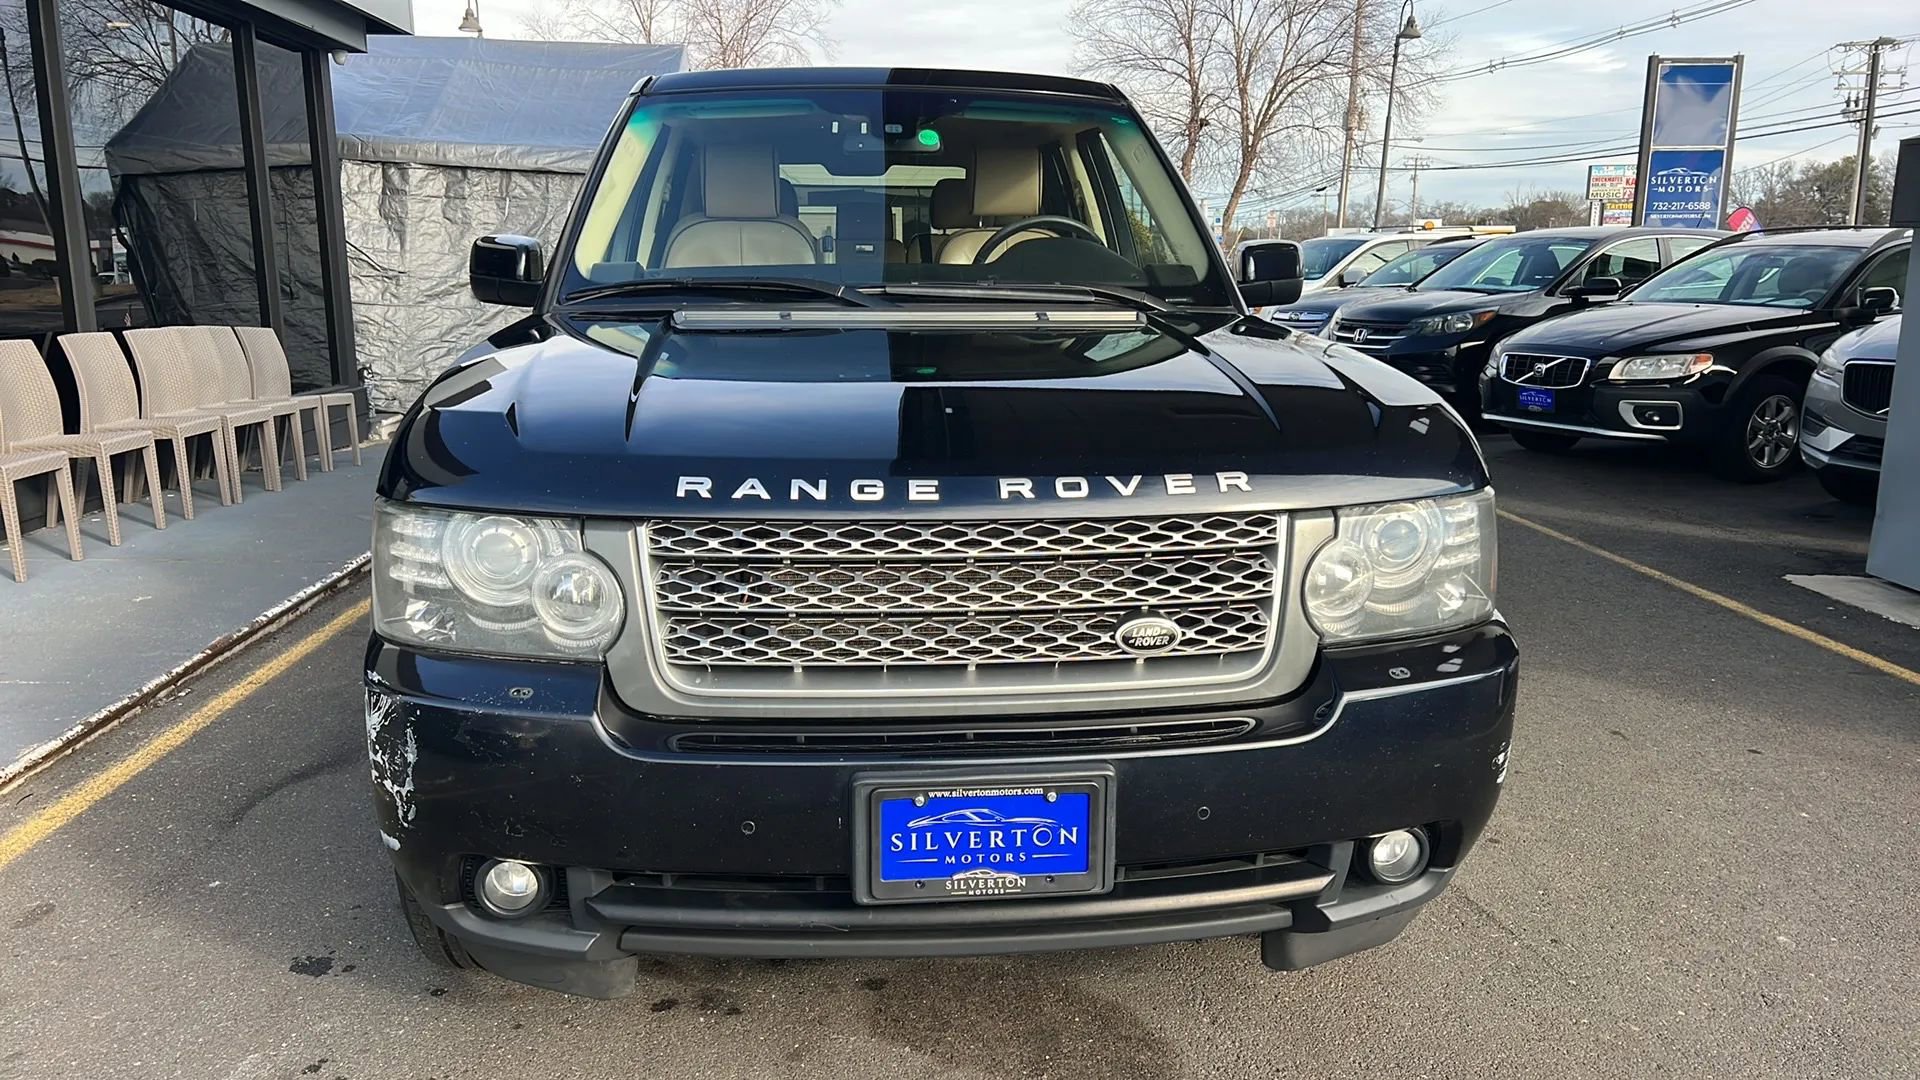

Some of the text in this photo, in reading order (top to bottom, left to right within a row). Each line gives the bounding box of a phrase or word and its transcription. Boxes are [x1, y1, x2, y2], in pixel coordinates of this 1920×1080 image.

[1651, 176, 1717, 185] SILVERTON
[1657, 185, 1709, 193] MOTORS
[1652, 202, 1711, 210] 732-217-6588
[676, 471, 1252, 502] RANGE ROVER
[1132, 626, 1160, 638] LAND
[1134, 635, 1170, 647] ROVER
[928, 787, 1044, 799] www.silvertonmotors.com
[890, 826, 1078, 852] SILVERTON
[944, 852, 1027, 865] MOTORS
[945, 877, 1027, 890] SILVERTON
[968, 888, 1005, 896] MOTORS
